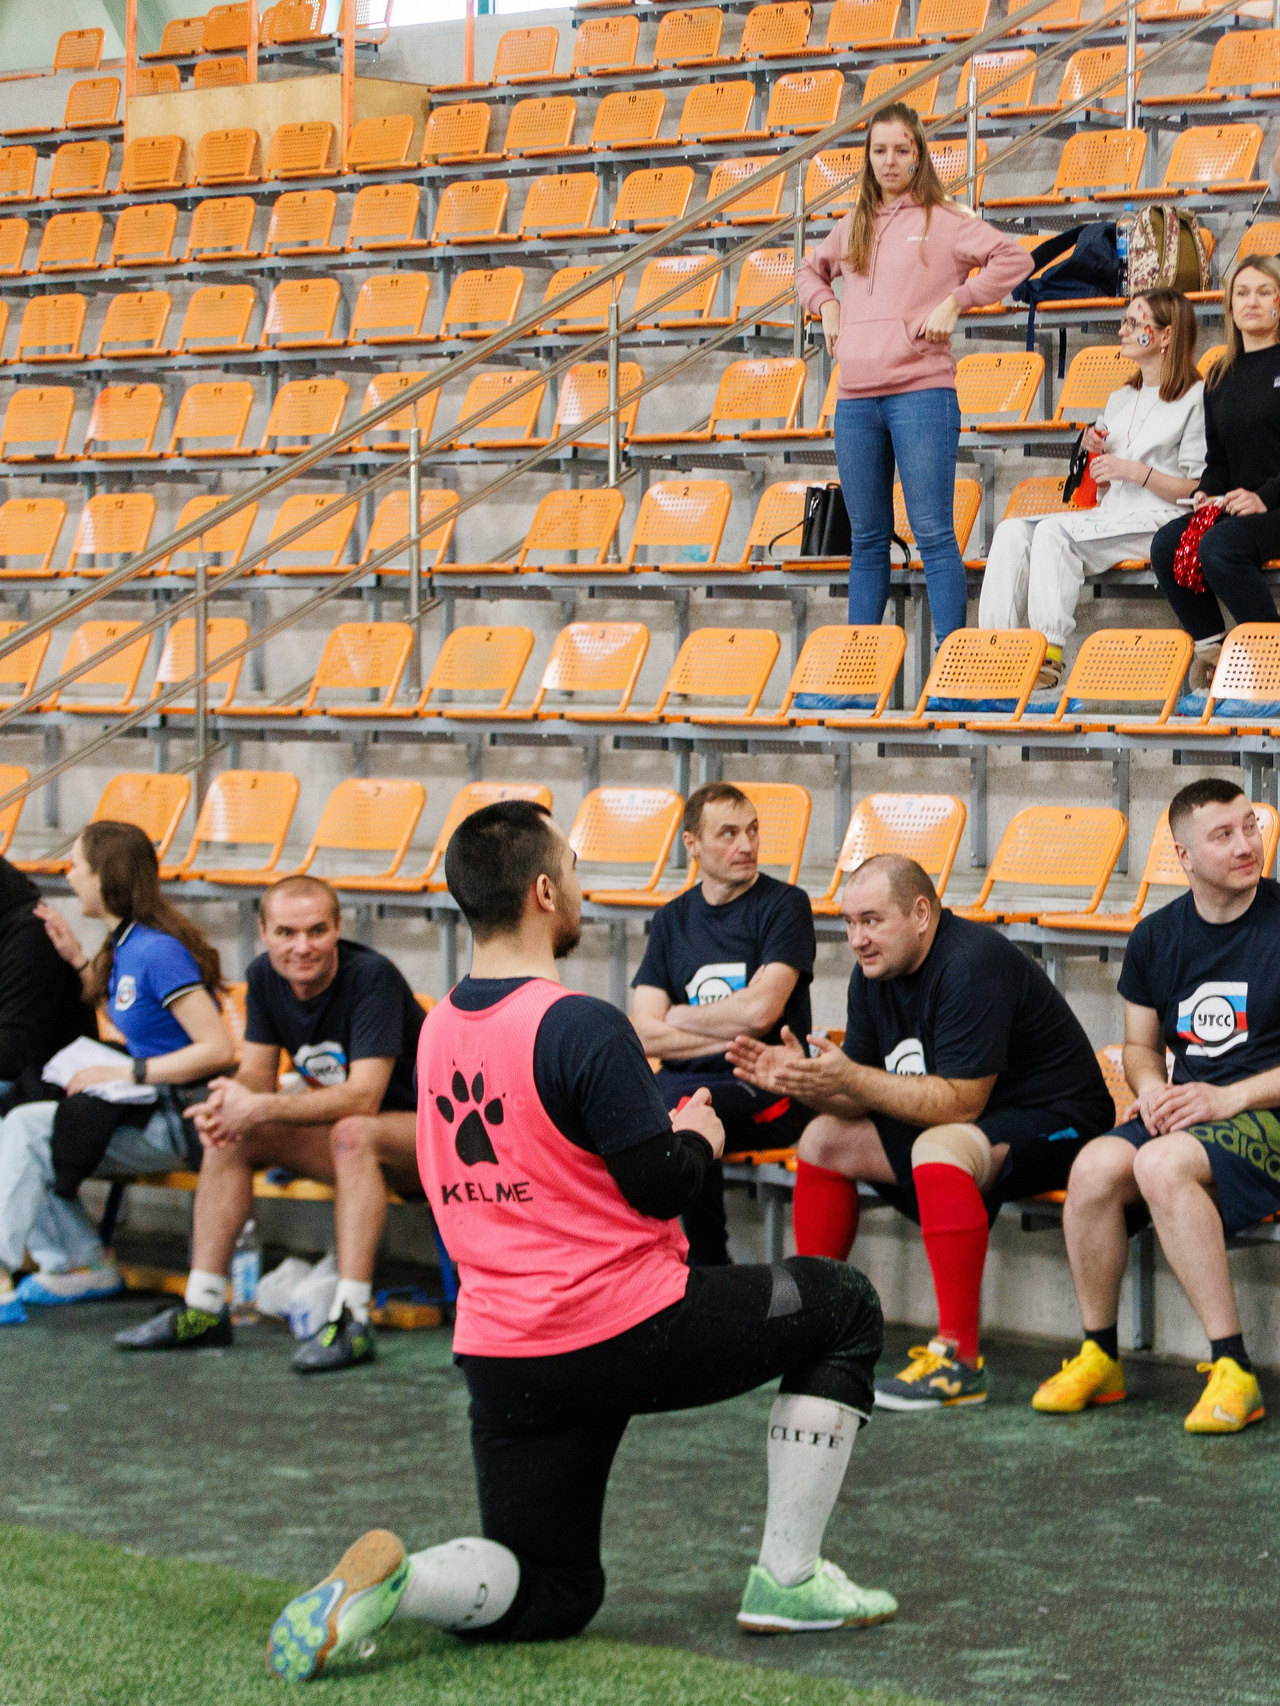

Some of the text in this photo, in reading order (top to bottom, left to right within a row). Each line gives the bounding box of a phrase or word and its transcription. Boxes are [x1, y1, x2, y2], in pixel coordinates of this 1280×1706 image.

[775, 7, 784, 16] 10
[995, 56, 1004, 65] 14
[1100, 52, 1111, 61] 15
[897, 68, 907, 77] 13
[802, 77, 812, 86] 12
[715, 86, 724, 95] 11
[1216, 130, 1223, 138] 2
[942, 146, 952, 155] 15
[841, 154, 851, 162] 14
[743, 162, 754, 172] 13
[653, 172, 663, 181] 12
[559, 179, 568, 187] 11
[471, 185, 479, 193] 10
[777, 253, 787, 262] 15
[677, 261, 687, 270] 14
[390, 278, 399, 287] 11
[484, 274, 493, 282] 12
[1114, 351, 1120, 360] 4
[995, 358, 1001, 367] 3
[597, 369, 607, 378] 15
[1058, 482, 1064, 491] 5
[683, 487, 689, 496] 2
[486, 631, 492, 641] 2
[728, 634, 735, 643] 4
[851, 631, 859, 641] 5
[989, 635, 997, 645] 6
[1134, 635, 1142, 645] 7
[1198, 1014, 1231, 1027] УТСС
[441, 1181, 533, 1205] KELME
